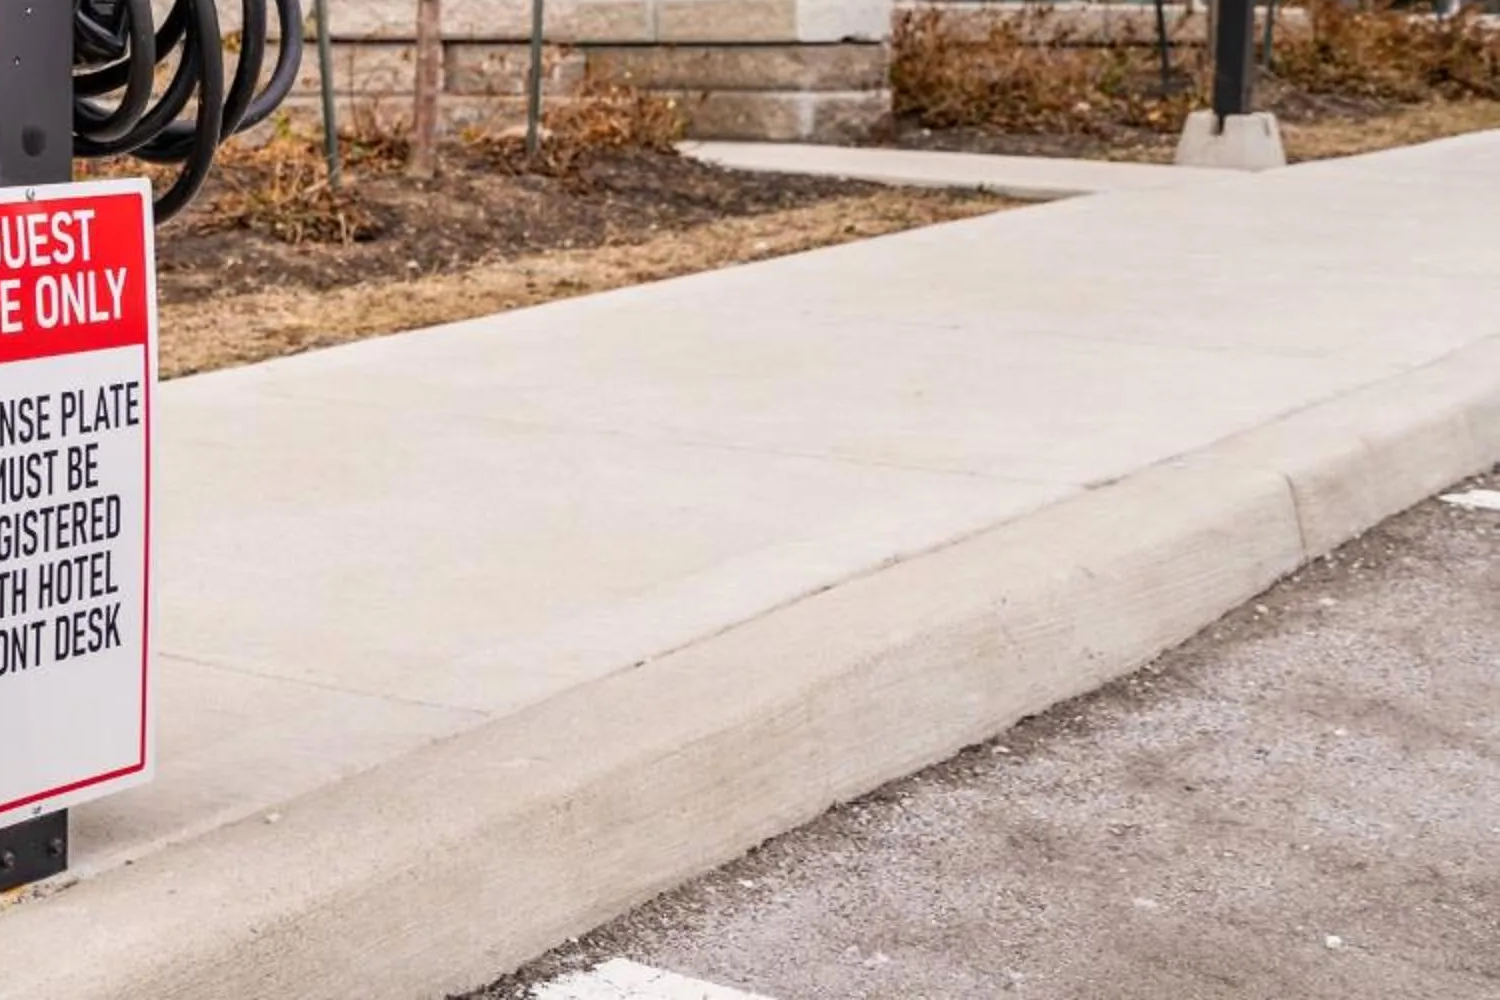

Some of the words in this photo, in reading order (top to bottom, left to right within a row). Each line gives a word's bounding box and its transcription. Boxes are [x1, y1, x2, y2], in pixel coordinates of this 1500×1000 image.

[35, 267, 127, 328] ONLY
[61, 381, 140, 437] PLATE
[67, 442, 99, 492] BE
[38, 549, 119, 610] HOTEL
[54, 602, 122, 662] DESK
